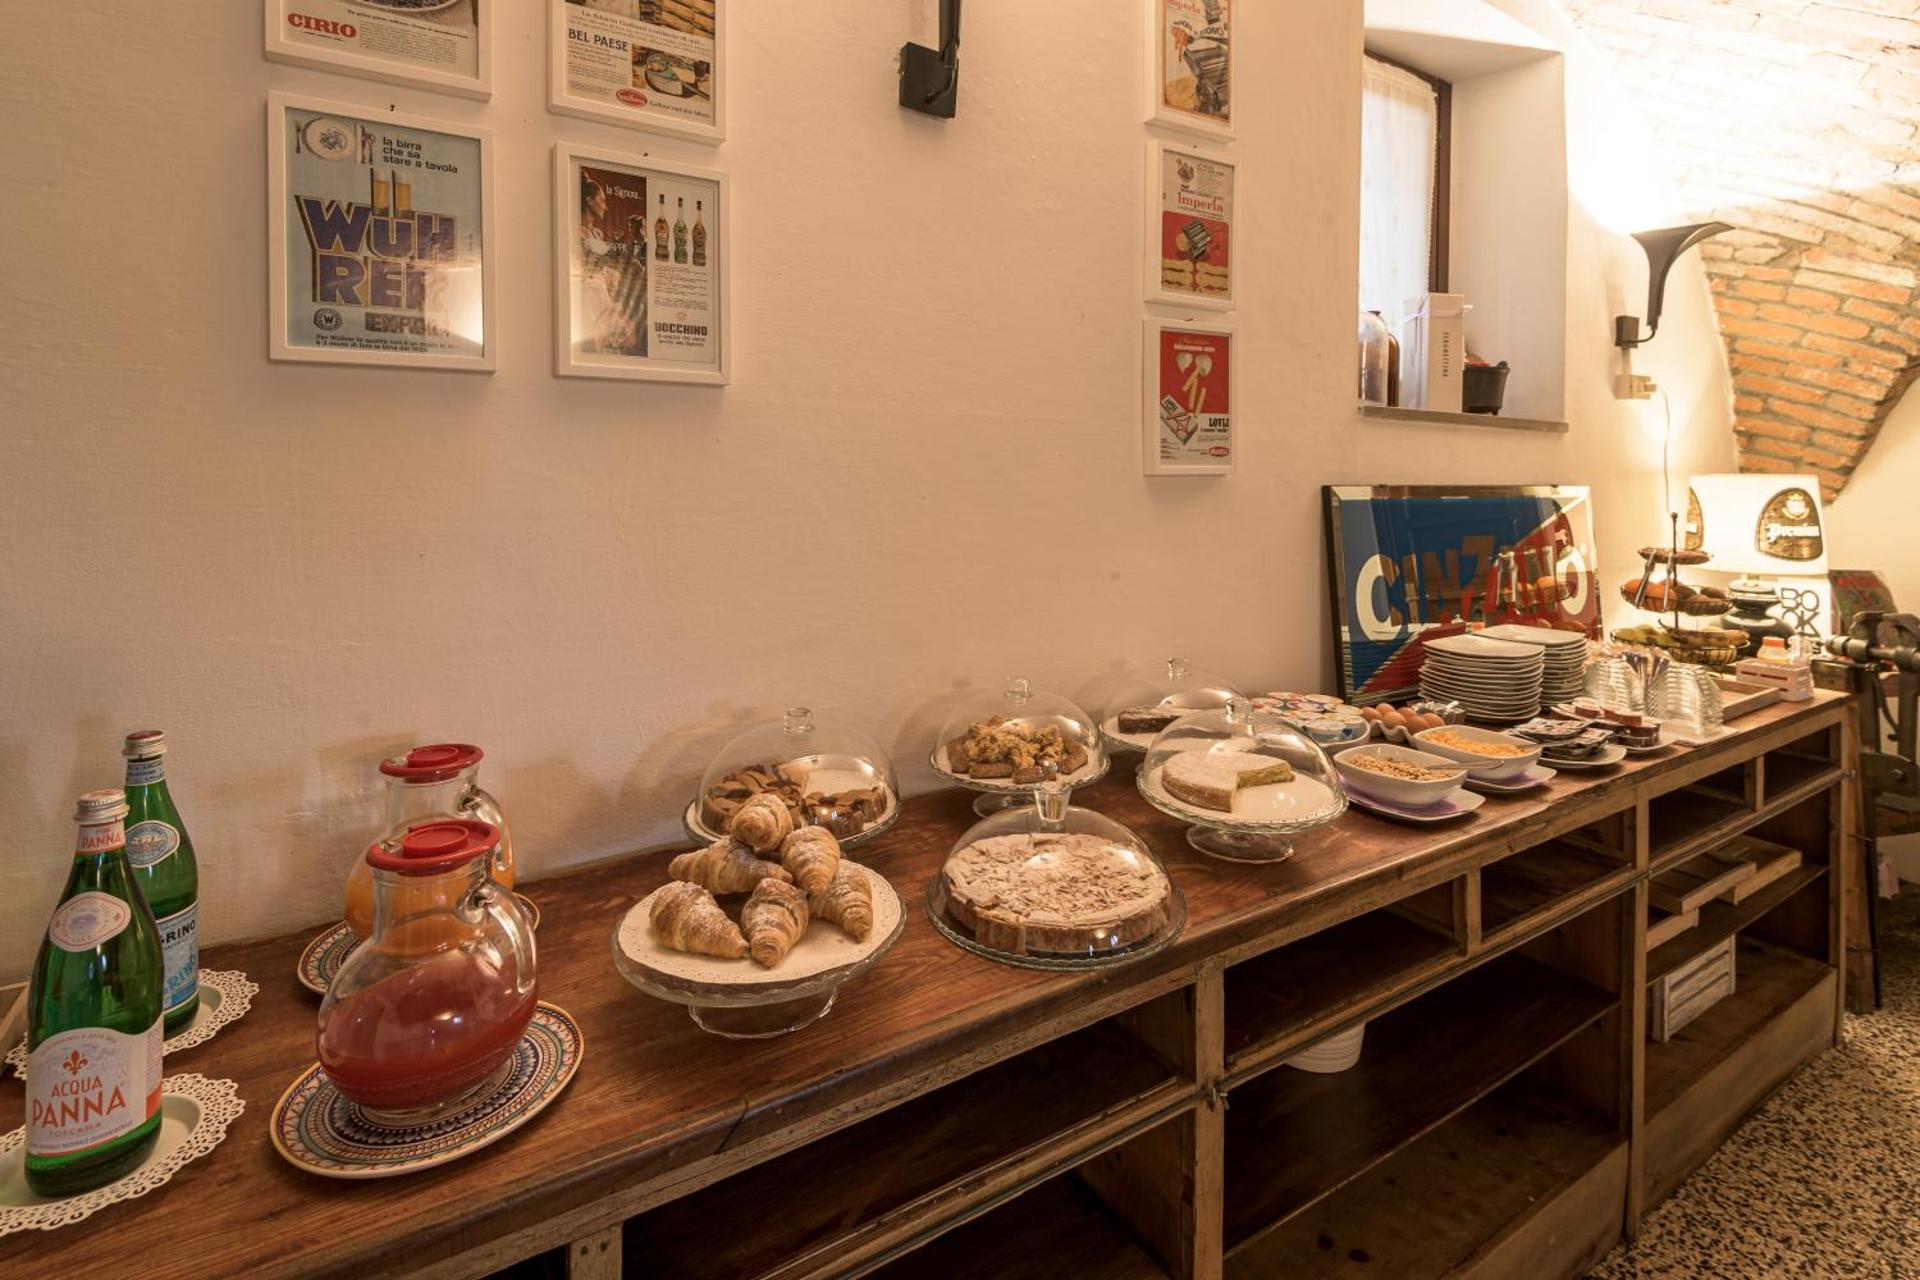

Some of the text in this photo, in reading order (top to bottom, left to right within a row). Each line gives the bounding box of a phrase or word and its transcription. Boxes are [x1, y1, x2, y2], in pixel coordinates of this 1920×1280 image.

[287, 12, 358, 39] CIRIO
[568, 28, 590, 43] BEL
[594, 34, 629, 52] PAESE
[383, 137, 422, 151] la birra
[383, 146, 421, 159] che sa
[382, 155, 458, 174] stare a tavola
[1177, 192, 1224, 213] Imperia
[82, 834, 122, 850] PANNA
[161, 919, 196, 944] RINO
[51, 1075, 103, 1099] ACQUA
[32, 1085, 127, 1129] PANNA
